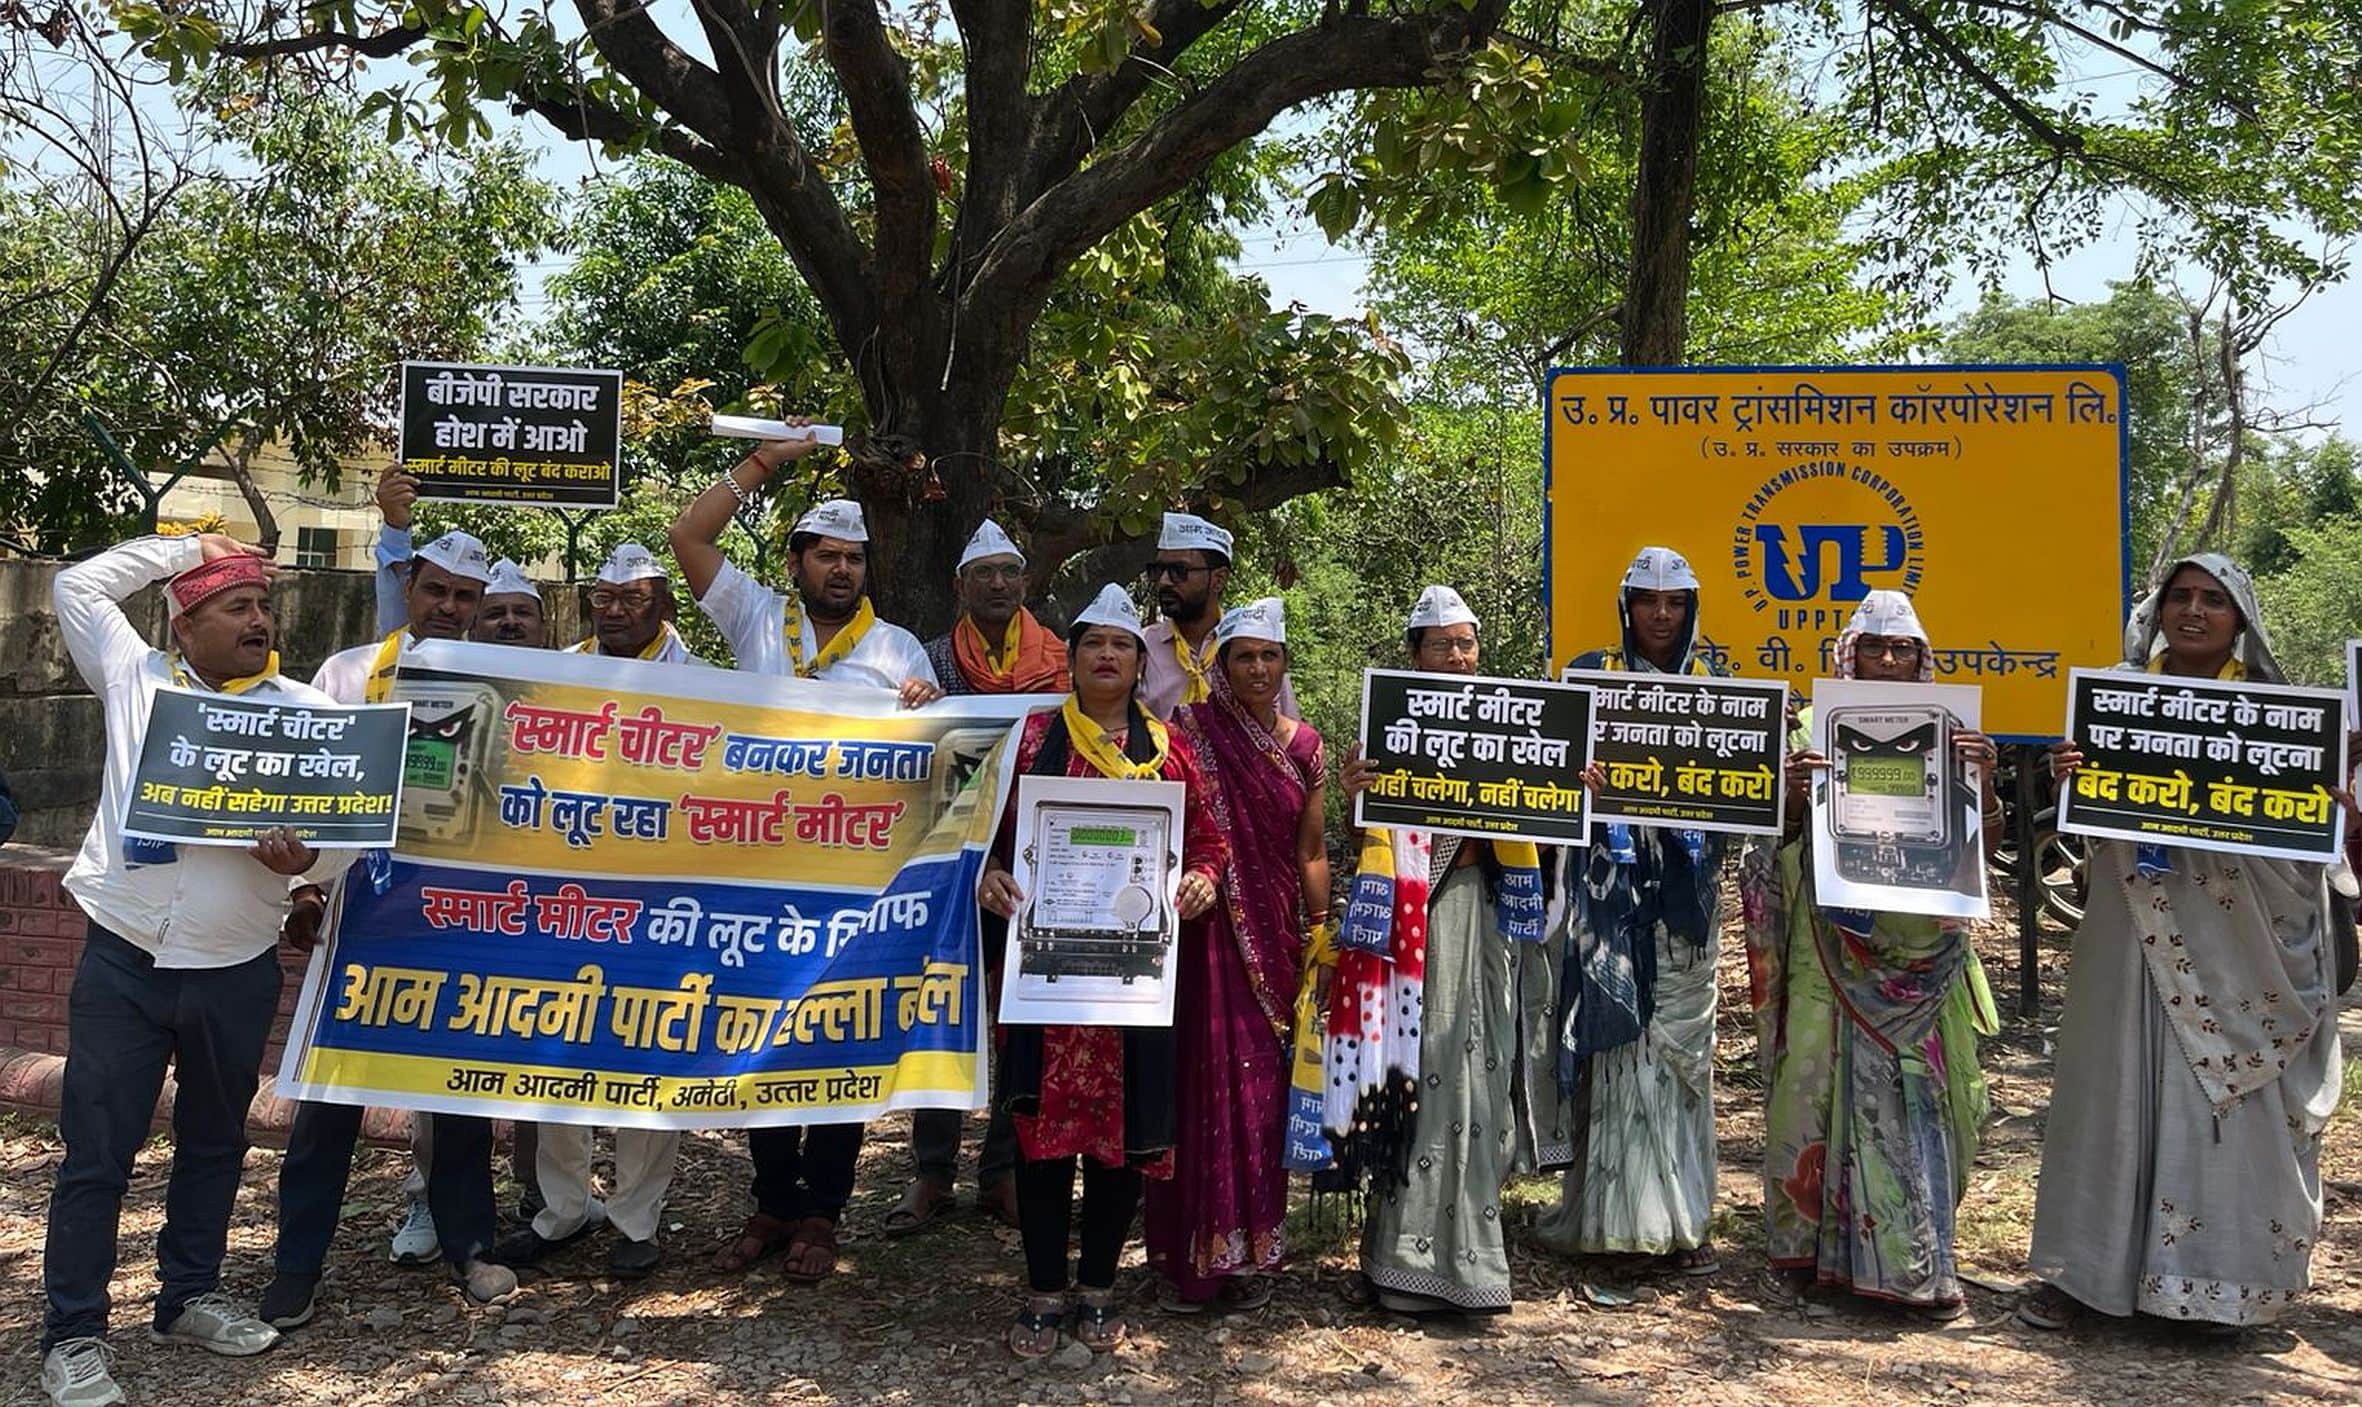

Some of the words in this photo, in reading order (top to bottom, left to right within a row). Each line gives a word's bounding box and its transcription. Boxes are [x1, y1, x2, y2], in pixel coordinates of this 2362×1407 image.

[425, 371, 504, 407] बीजेपी
[507, 382, 599, 411] सरकार
[1650, 396, 1720, 425] पावर
[1731, 382, 1876, 432] ट्रांसमिशन
[1888, 382, 2054, 425] कॉरपोरेशन
[434, 415, 488, 449] होश
[490, 416, 521, 450] में
[523, 418, 588, 453] आओ
[1776, 441, 1839, 457] सरकार
[1851, 442, 1876, 457] का
[406, 455, 446, 475] स्मार्ट
[448, 456, 488, 477] मीटर
[489, 458, 511, 477] की
[513, 462, 538, 483] लूट
[540, 460, 562, 479] बंद
[563, 461, 612, 481] कराओ
[1742, 461, 1846, 521] TRANSMISSION
[1851, 466, 1924, 549] CORPORATION
[1733, 525, 1752, 579] POWER
[1779, 609, 1855, 630] UPPT
[1406, 685, 1474, 721] स्मार्ट
[1476, 687, 1545, 727] मीटर
[1596, 683, 1636, 710] मार्ट
[1637, 685, 1693, 715] मीटर
[1695, 688, 1718, 716] के
[1720, 696, 1769, 719] नाम
[2091, 686, 2158, 717] स्मार्ट
[2160, 690, 2230, 723] मीटर
[2232, 695, 2262, 726] के
[2263, 705, 2325, 733] नाम
[170, 735, 202, 767] के
[203, 748, 252, 782] लूट
[255, 752, 298, 777] का
[298, 747, 365, 783] खेल,
[724, 733, 832, 776] बनकर
[836, 738, 935, 780] जनता
[1384, 718, 1421, 755] की
[1423, 729, 1468, 768] लूट
[1470, 732, 1507, 763] का
[1510, 729, 1570, 767] खेल
[1610, 721, 1671, 747] जनता
[1673, 720, 1703, 749] को
[1705, 728, 1768, 758] लूटना
[2088, 723, 2125, 750] पर
[2127, 728, 2202, 759] जनता
[2204, 732, 2243, 763] को
[2246, 740, 2325, 776] लूटना
[140, 782, 178, 806] अब
[181, 786, 230, 811] नहीं
[227, 787, 287, 813] सहेगा
[290, 794, 335, 815] उत्तर
[336, 790, 393, 816] प्रदेश!
[1412, 773, 1474, 807] चलेगा,
[1479, 777, 1525, 807] नहीं
[1523, 781, 1581, 813] चलेगा
[1609, 757, 1669, 798] करो,
[1676, 760, 1716, 796] बंद
[1718, 765, 1775, 800] करो
[2075, 761, 2123, 801] बंद
[2125, 769, 2201, 816] करो,
[2208, 776, 2257, 815] बंद
[2262, 784, 2333, 824] करो
[500, 776, 547, 828] को
[550, 790, 609, 848] लूट
[611, 797, 672, 839] रहा
[1501, 892, 1543, 911] आदमी
[1504, 873, 1533, 889] आम
[421, 880, 529, 934] स्मार्ट
[534, 884, 643, 944] मीटर
[648, 897, 702, 946] की
[708, 912, 772, 967] लूट
[777, 905, 821, 956] के
[335, 964, 449, 1030] आम
[449, 964, 606, 1044] आदमी
[610, 972, 714, 1053] पार्टी
[714, 994, 782, 1055] का
[446, 1067, 507, 1094] आम
[513, 1072, 599, 1105] आदमी
[605, 1077, 662, 1112] पार्टी,
[671, 1079, 748, 1110] अमेठी,
[755, 1078, 820, 1103] उत्तर
[825, 1070, 882, 1103] प्रदेश
